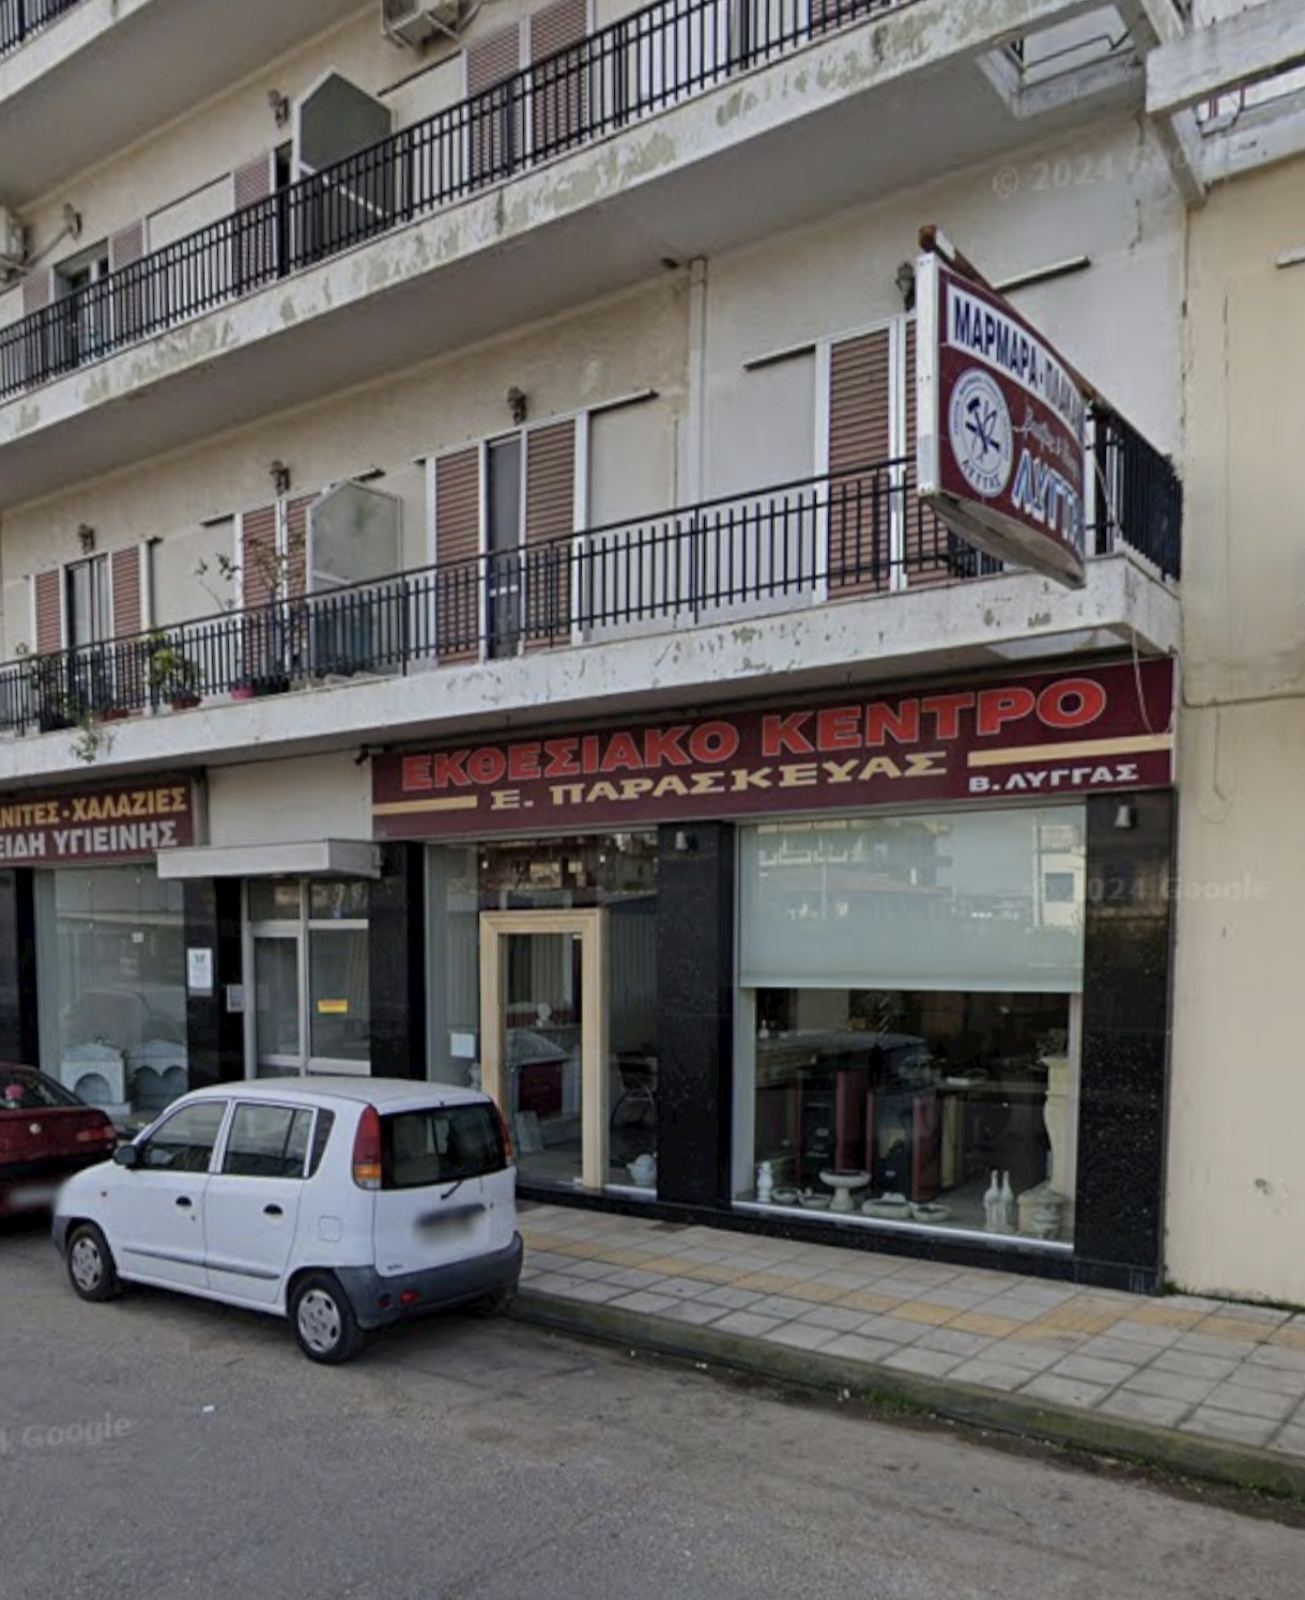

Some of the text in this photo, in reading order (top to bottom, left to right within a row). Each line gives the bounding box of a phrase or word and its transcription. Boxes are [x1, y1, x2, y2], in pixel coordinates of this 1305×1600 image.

[954, 295, 1038, 391] ΜΑΡΜΑΡΑ
[402, 677, 1107, 792] ΕΚΘΕΣΙΑΚΟ ΚΕΝΤΡΟ
[72, 786, 187, 822] ΧΑΛΑΖΙΕΣ
[549, 751, 948, 805] ΠΑΡΑΣΚΕΥΑΣ
[0, 820, 178, 860] ΕΙΔΗ ΥΓΙΕΙΝΗΣ
